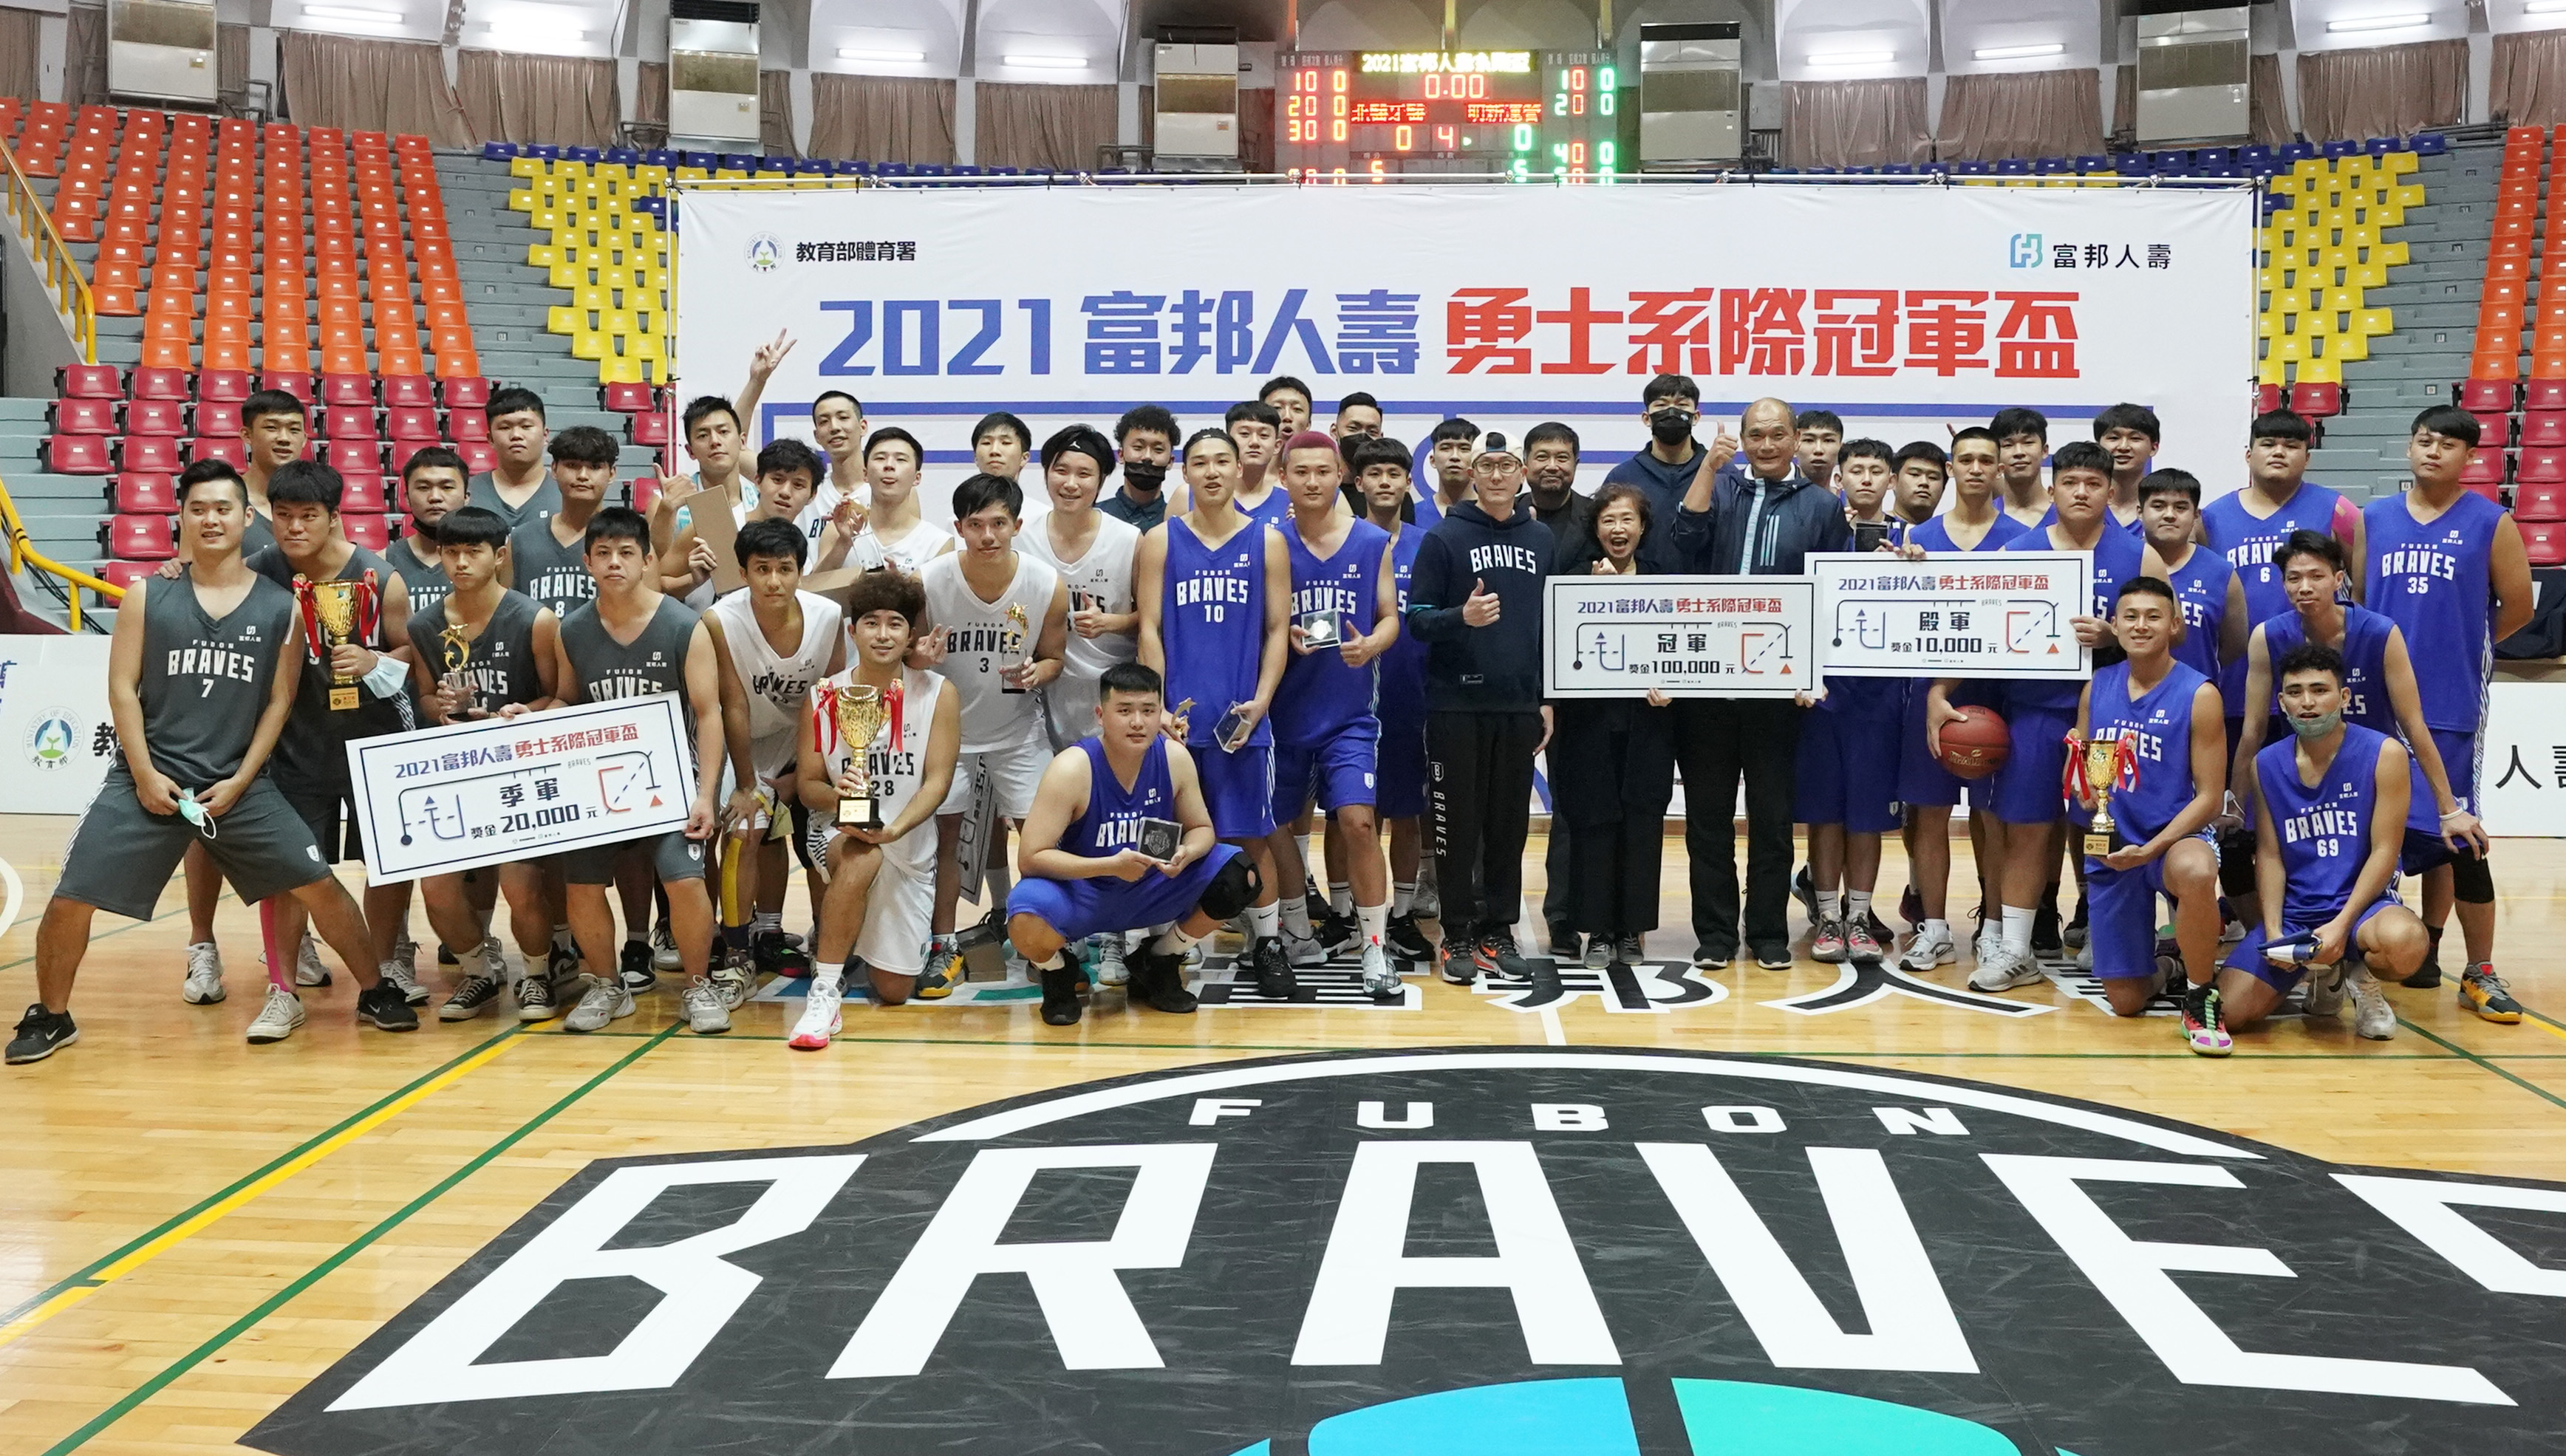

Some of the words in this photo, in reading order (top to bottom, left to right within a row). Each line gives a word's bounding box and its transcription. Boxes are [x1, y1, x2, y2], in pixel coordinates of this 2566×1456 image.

[1295, 72, 1301, 92] 1
[1305, 71, 1317, 92] 0
[1333, 70, 1346, 92] 0
[1562, 69, 1569, 90] 1
[1572, 69, 1584, 90] 0
[1600, 68, 1615, 92] 0
[1289, 95, 1300, 116] 2
[1305, 95, 1317, 116] 0
[1333, 95, 1346, 116] 0
[1555, 93, 1568, 115] 2
[1572, 93, 1584, 115] 0
[1600, 92, 1614, 115] 0
[1289, 119, 1300, 141] 3
[1305, 119, 1317, 140] 0
[1333, 119, 1346, 141] 0
[1396, 125, 1412, 151] 0
[1438, 126, 1453, 149] 4
[1514, 123, 1532, 151] 0
[1554, 143, 1568, 163] 4
[1572, 143, 1584, 163] 0
[1599, 141, 1614, 165] 0
[796, 241, 916, 262] 教育部體育署
[2053, 244, 2171, 269] 富邦人壽
[819, 299, 1050, 376] 2021
[1081, 289, 1420, 375] 富邦人壽
[1446, 287, 2080, 378] 勇士系際冠軍盃
[1470, 544, 1536, 575] BRAVES
[2382, 550, 2456, 581] BRAVES
[2260, 567, 2270, 582] 6
[2407, 577, 2429, 594] 35
[530, 574, 597, 601] BRAVES
[1176, 577, 1249, 606] BRAVES
[556, 601, 565, 618] 8
[1204, 605, 1224, 622] 10
[1915, 638, 1982, 654] 10,000
[1987, 643, 1998, 653] 元
[168, 649, 255, 683] BRAVES
[980, 657, 989, 673] 3
[1652, 660, 1720, 675] 100,000
[1725, 664, 1736, 674] 元
[201, 679, 214, 697] 7
[568, 758, 591, 769] BRAVES
[870, 780, 894, 796] 28
[500, 804, 580, 833] 20,000
[586, 806, 598, 818] 元
[1433, 791, 1446, 857] BRAVES
[2285, 810, 2357, 843] BRAVES
[2316, 838, 2339, 857] 69
[1187, 1096, 1973, 1138] FUBON
